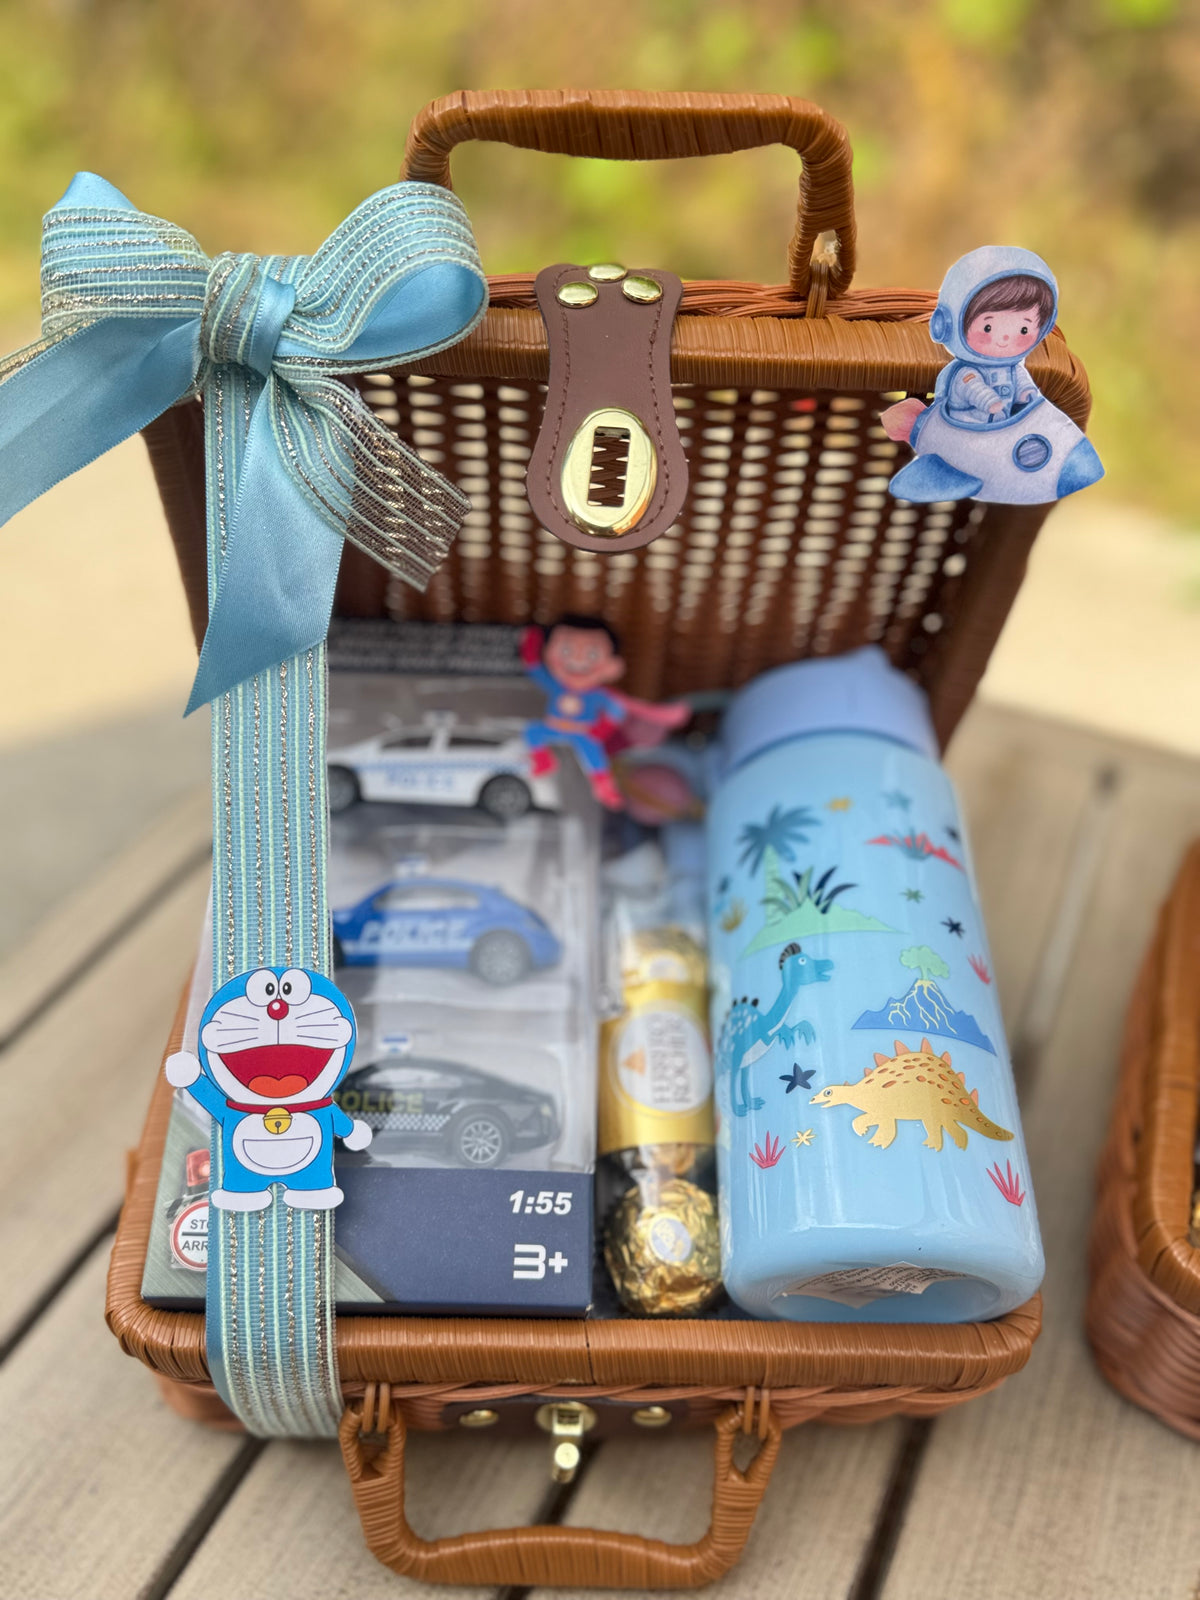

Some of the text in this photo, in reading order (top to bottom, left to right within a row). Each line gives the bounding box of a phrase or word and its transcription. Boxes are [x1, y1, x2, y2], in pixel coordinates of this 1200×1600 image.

[360, 919, 468, 945] POLICE
[509, 1190, 573, 1215] 1:55
[190, 1218, 209, 1230] ST
[513, 1243, 569, 1280] 3+
